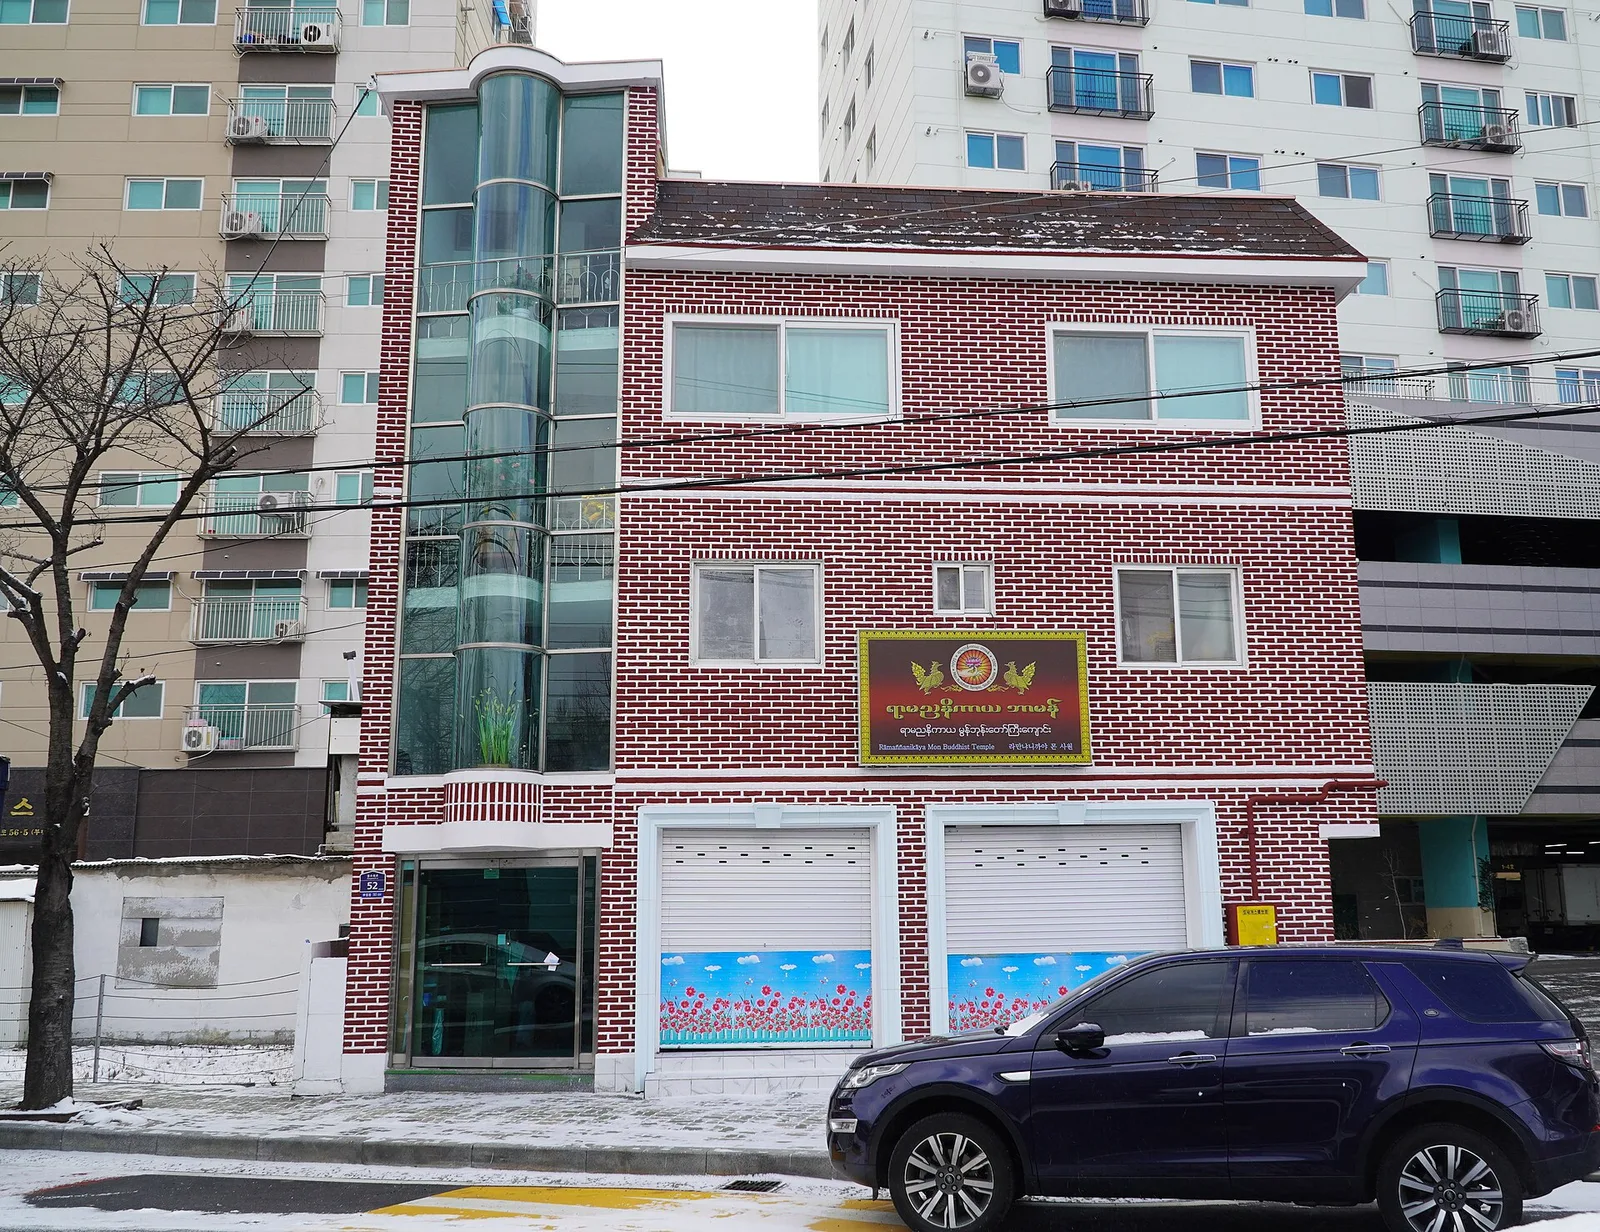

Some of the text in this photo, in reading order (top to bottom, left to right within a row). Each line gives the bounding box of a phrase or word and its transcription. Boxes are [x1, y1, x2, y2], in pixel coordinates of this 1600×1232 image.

[927, 743, 941, 751] Mon
[942, 743, 970, 751] Buddhist
[971, 743, 995, 751] Temple
[1059, 742, 1074, 751] 사원
[9, 797, 35, 816] 스
[367, 882, 378, 890] 52
